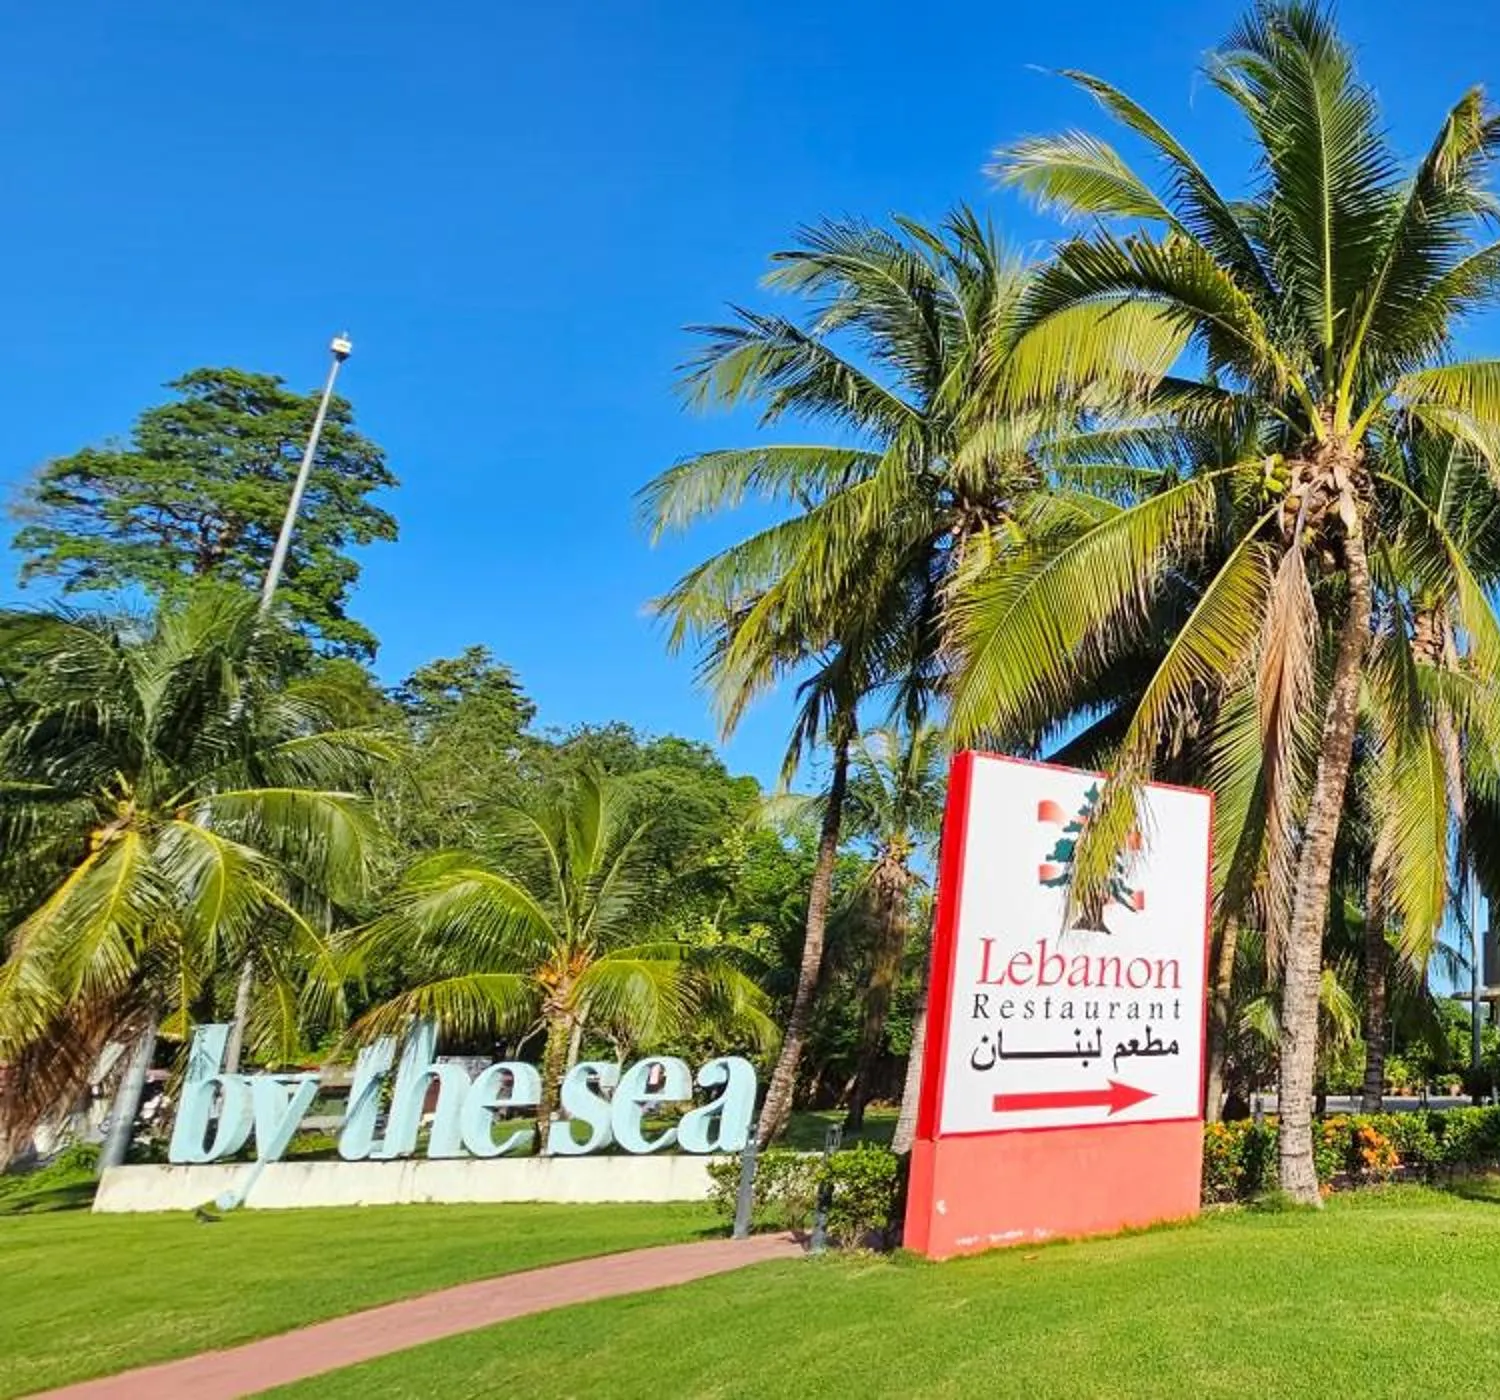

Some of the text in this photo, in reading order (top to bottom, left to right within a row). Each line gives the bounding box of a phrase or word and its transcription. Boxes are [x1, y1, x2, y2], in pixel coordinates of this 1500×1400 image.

[976, 937, 1182, 989] Lebanon
[971, 993, 1181, 1020] Restaurant
[1112, 1024, 1180, 1073] مطعم
[168, 1014, 758, 1210] by the sea
